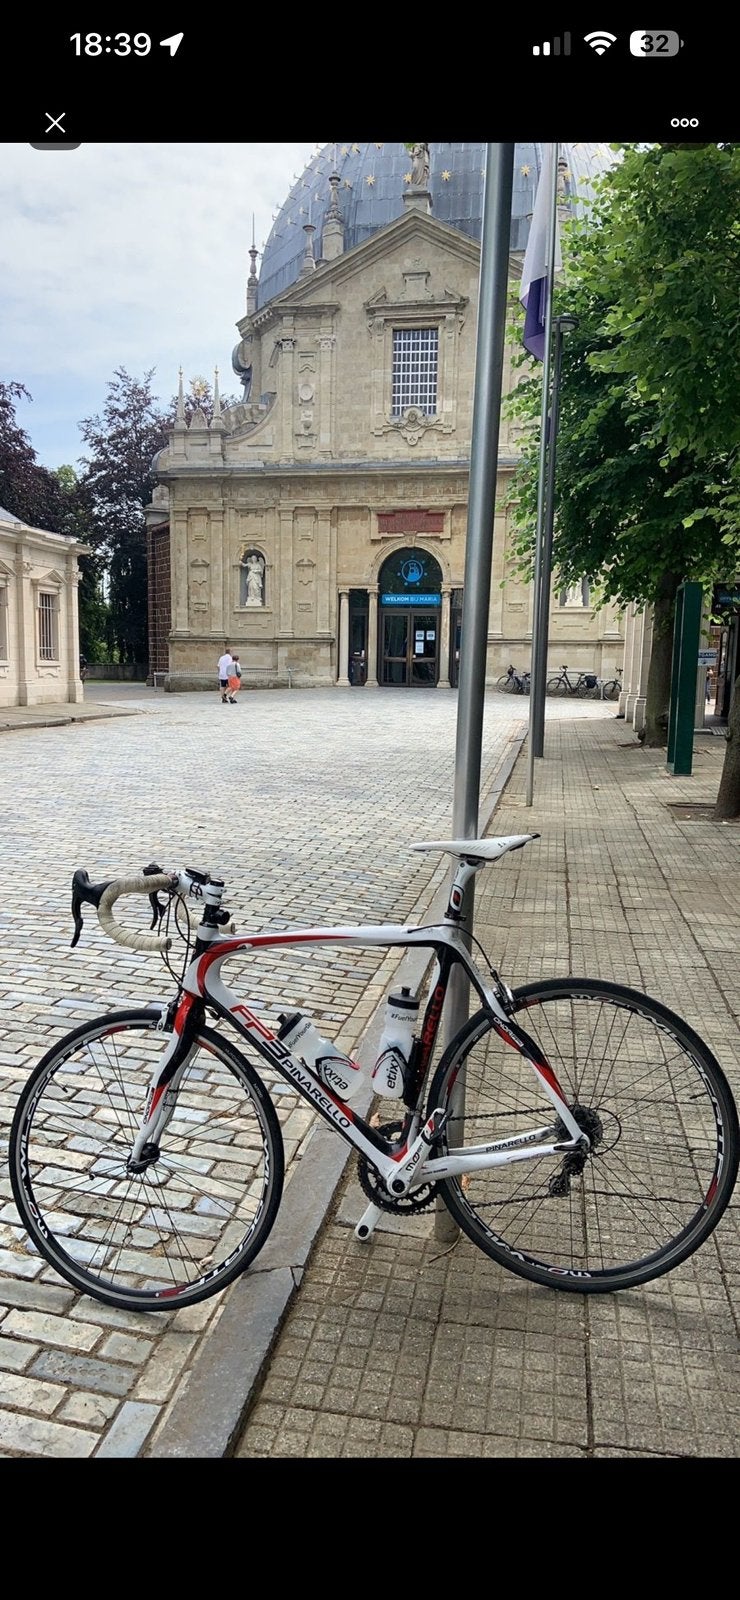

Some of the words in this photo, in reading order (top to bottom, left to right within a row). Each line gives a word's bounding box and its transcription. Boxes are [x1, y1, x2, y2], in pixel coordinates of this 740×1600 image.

[384, 595, 409, 603] WELKOM
[410, 595, 419, 603] BIJ
[419, 595, 438, 603] MARIA
[229, 1004, 292, 1061] FP3
[323, 1064, 349, 1091] etixx
[282, 1058, 351, 1129] PINARELLO
[485, 1134, 537, 1154] PINARELLO
